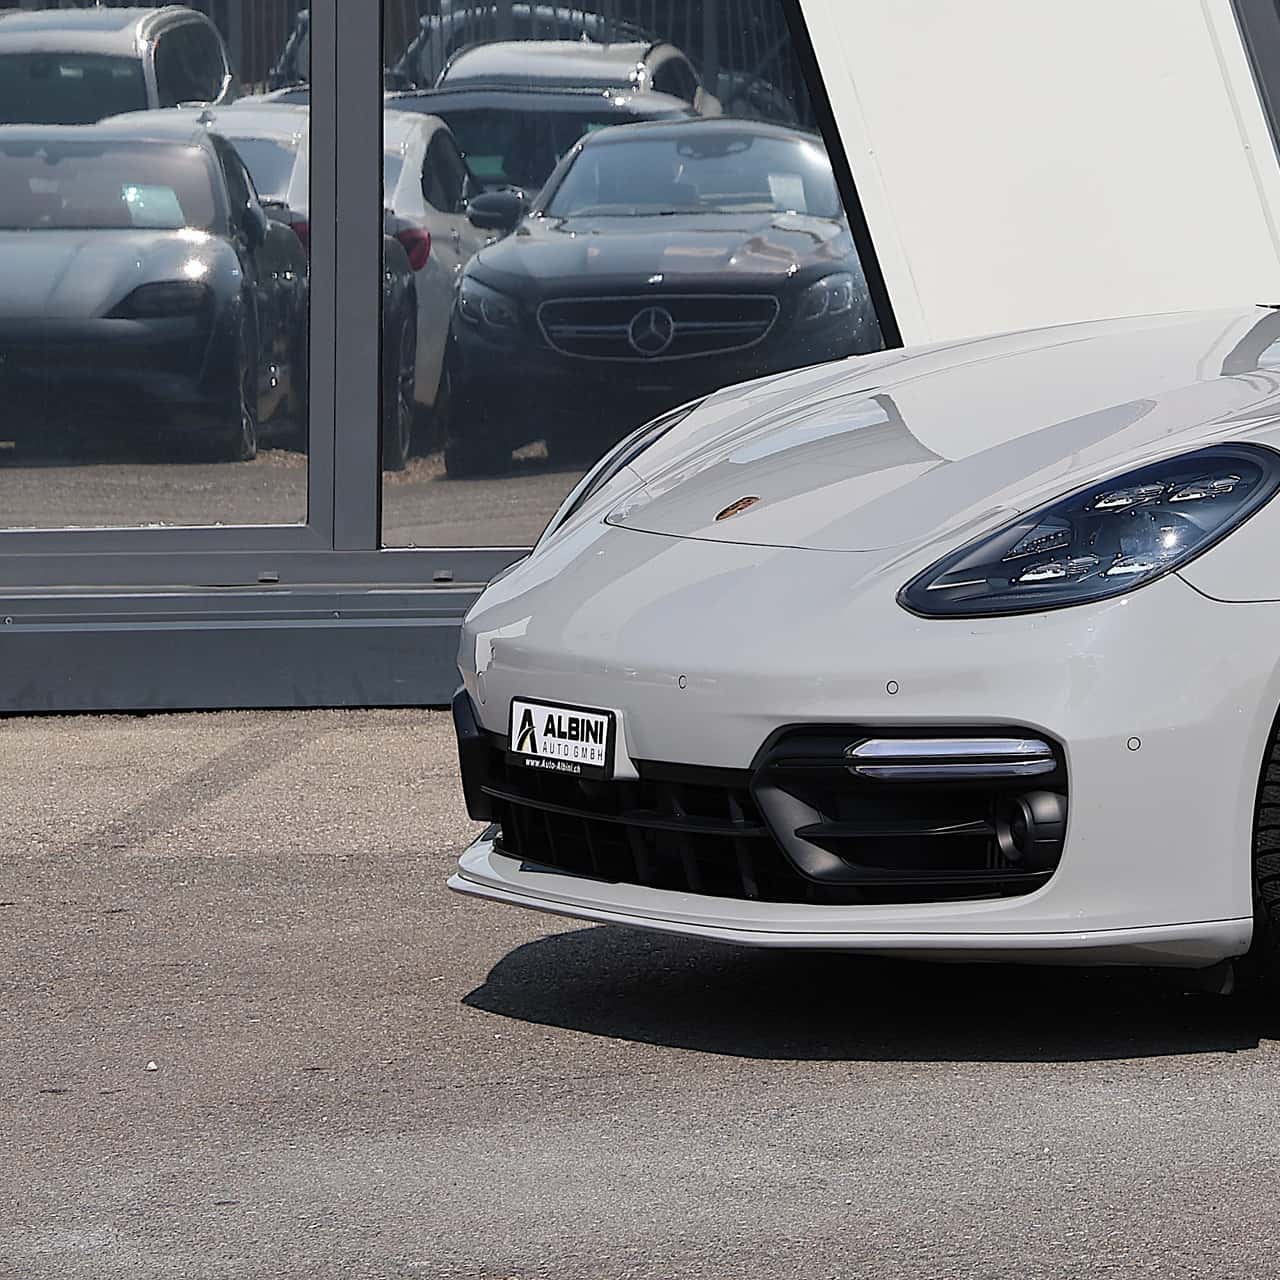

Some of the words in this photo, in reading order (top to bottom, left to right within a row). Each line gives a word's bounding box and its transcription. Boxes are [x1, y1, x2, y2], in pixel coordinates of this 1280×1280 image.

[543, 714, 604, 744] ALBINI
[542, 741, 569, 757] AUTO
[573, 745, 603, 761] GMBH
